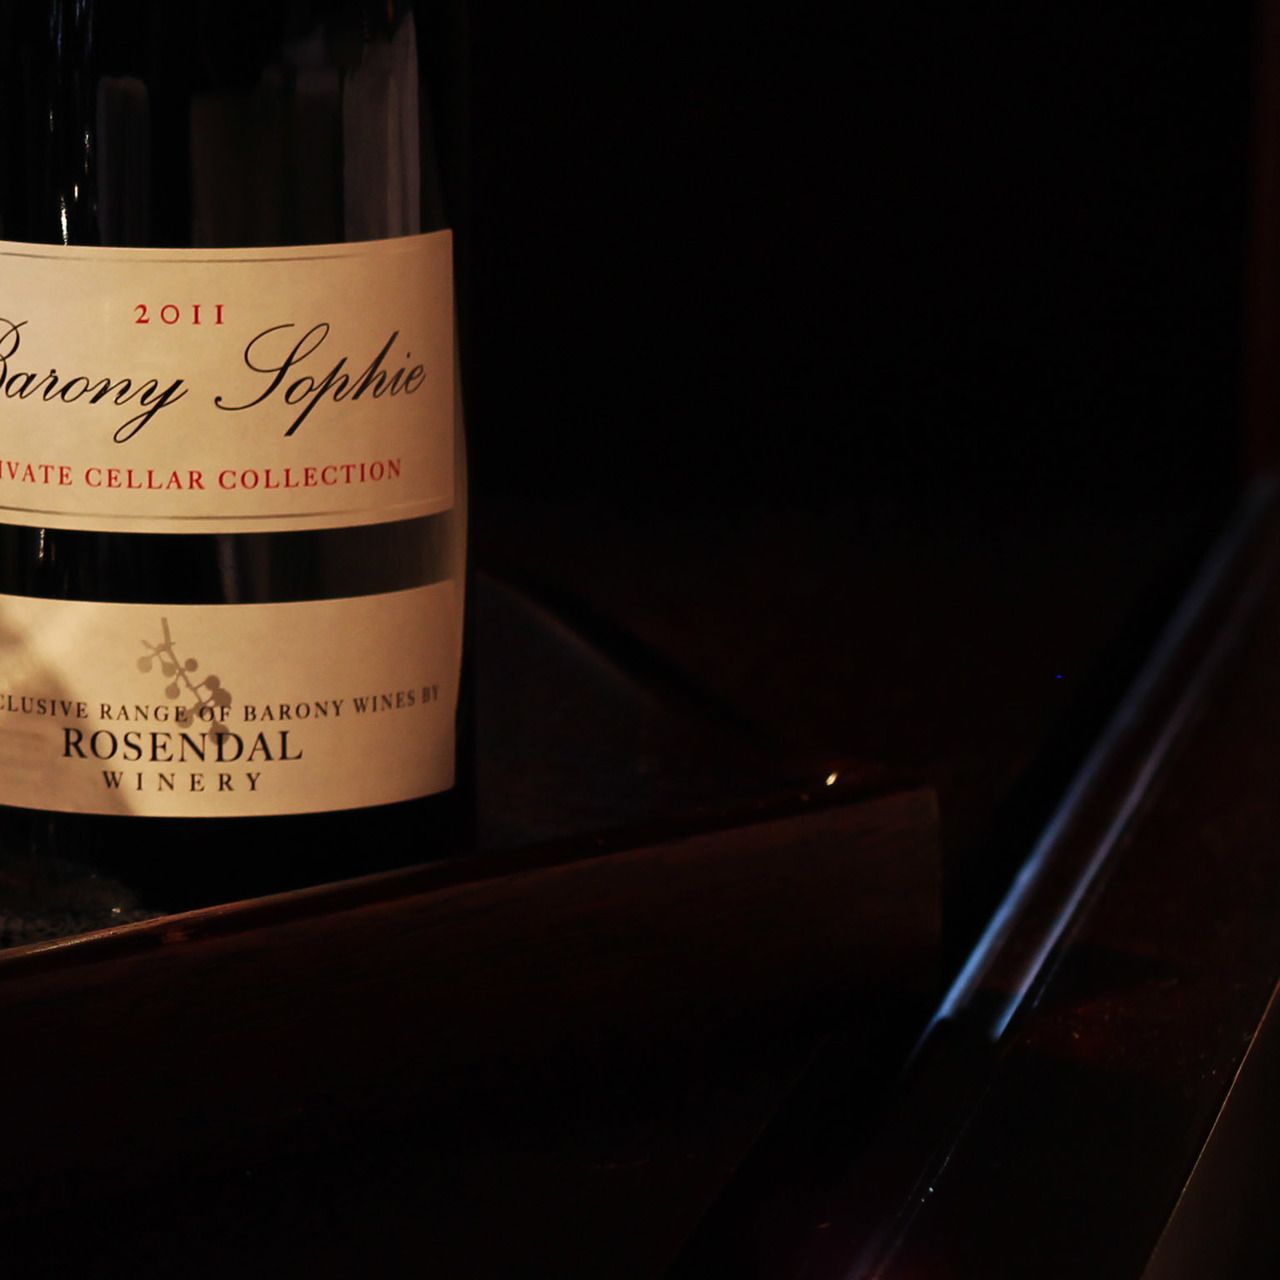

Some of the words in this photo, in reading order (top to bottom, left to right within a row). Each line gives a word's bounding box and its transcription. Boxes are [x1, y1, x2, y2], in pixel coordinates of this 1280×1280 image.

[133, 303, 225, 325] 2011
[214, 322, 427, 438] Sophie
[84, 467, 205, 490] CELLAR
[218, 458, 402, 490] COLLECTION
[99, 703, 188, 722] RANGE
[198, 705, 232, 722] OF
[243, 699, 344, 722] BARONY
[352, 692, 416, 714] WINES
[421, 684, 440, 704] BY
[62, 726, 304, 763] ROSENDAL
[102, 770, 262, 792] WINERY
